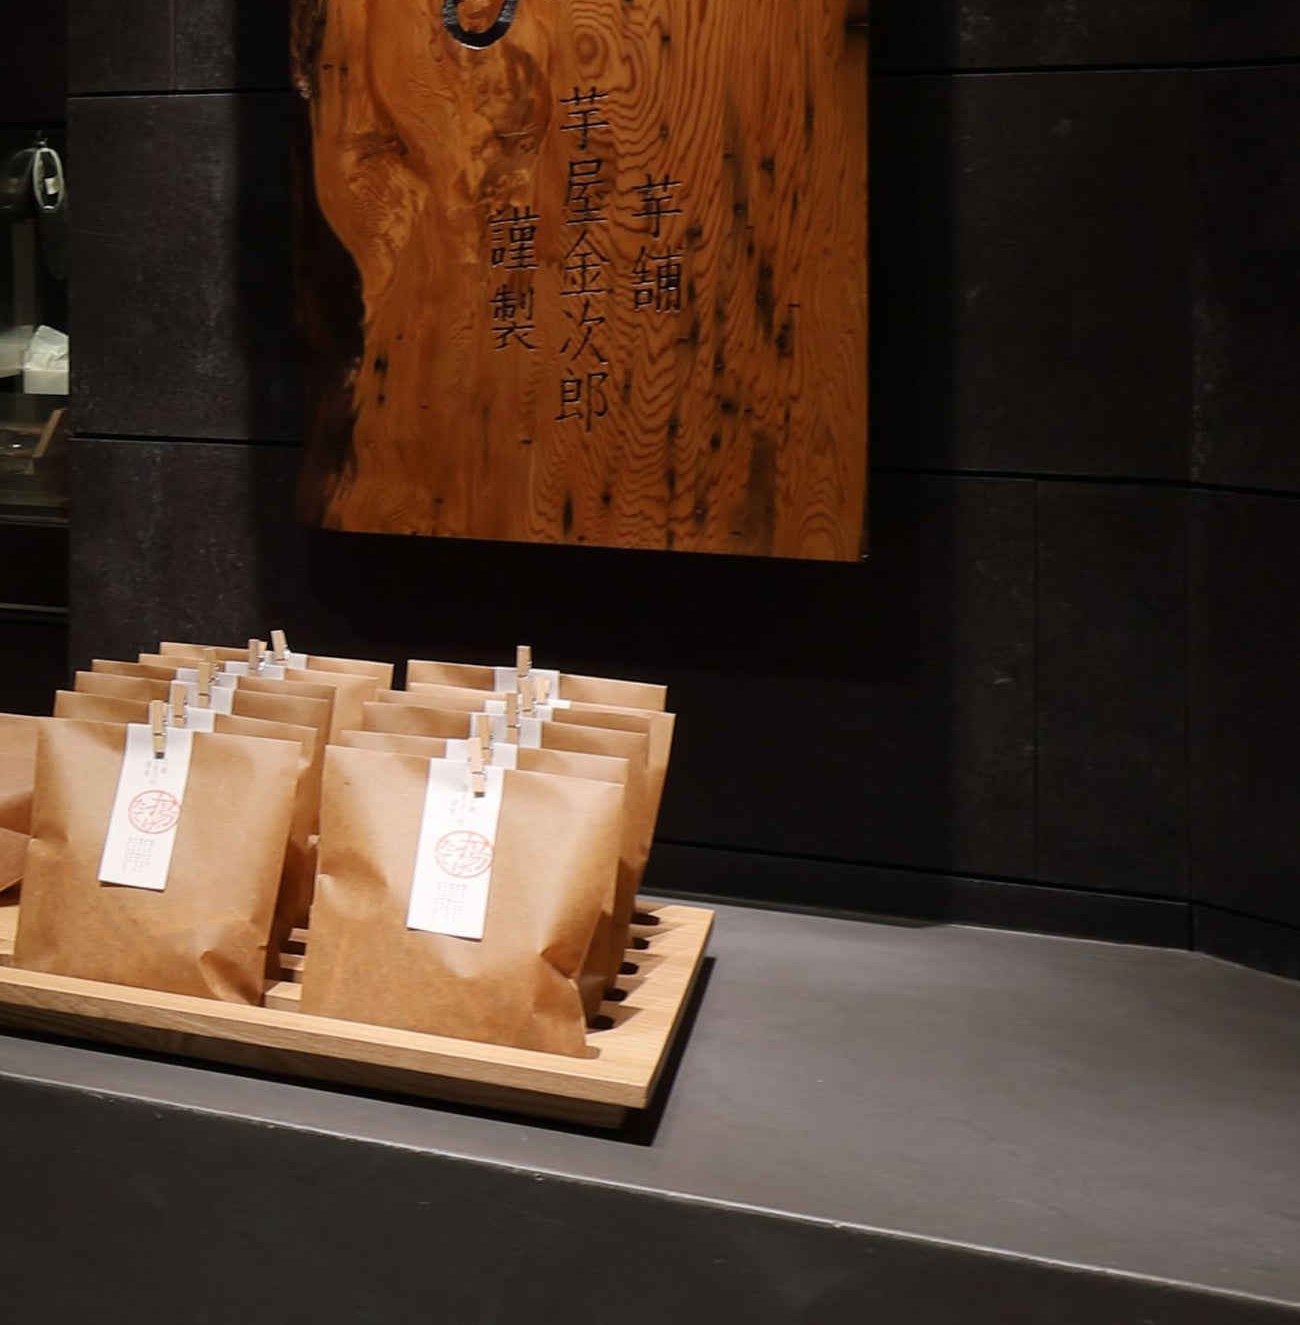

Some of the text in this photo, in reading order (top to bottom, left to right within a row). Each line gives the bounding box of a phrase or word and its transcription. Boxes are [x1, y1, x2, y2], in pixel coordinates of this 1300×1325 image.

[488, 206, 541, 350] 謹製
[555, 86, 609, 432] 芋屋金次郎
